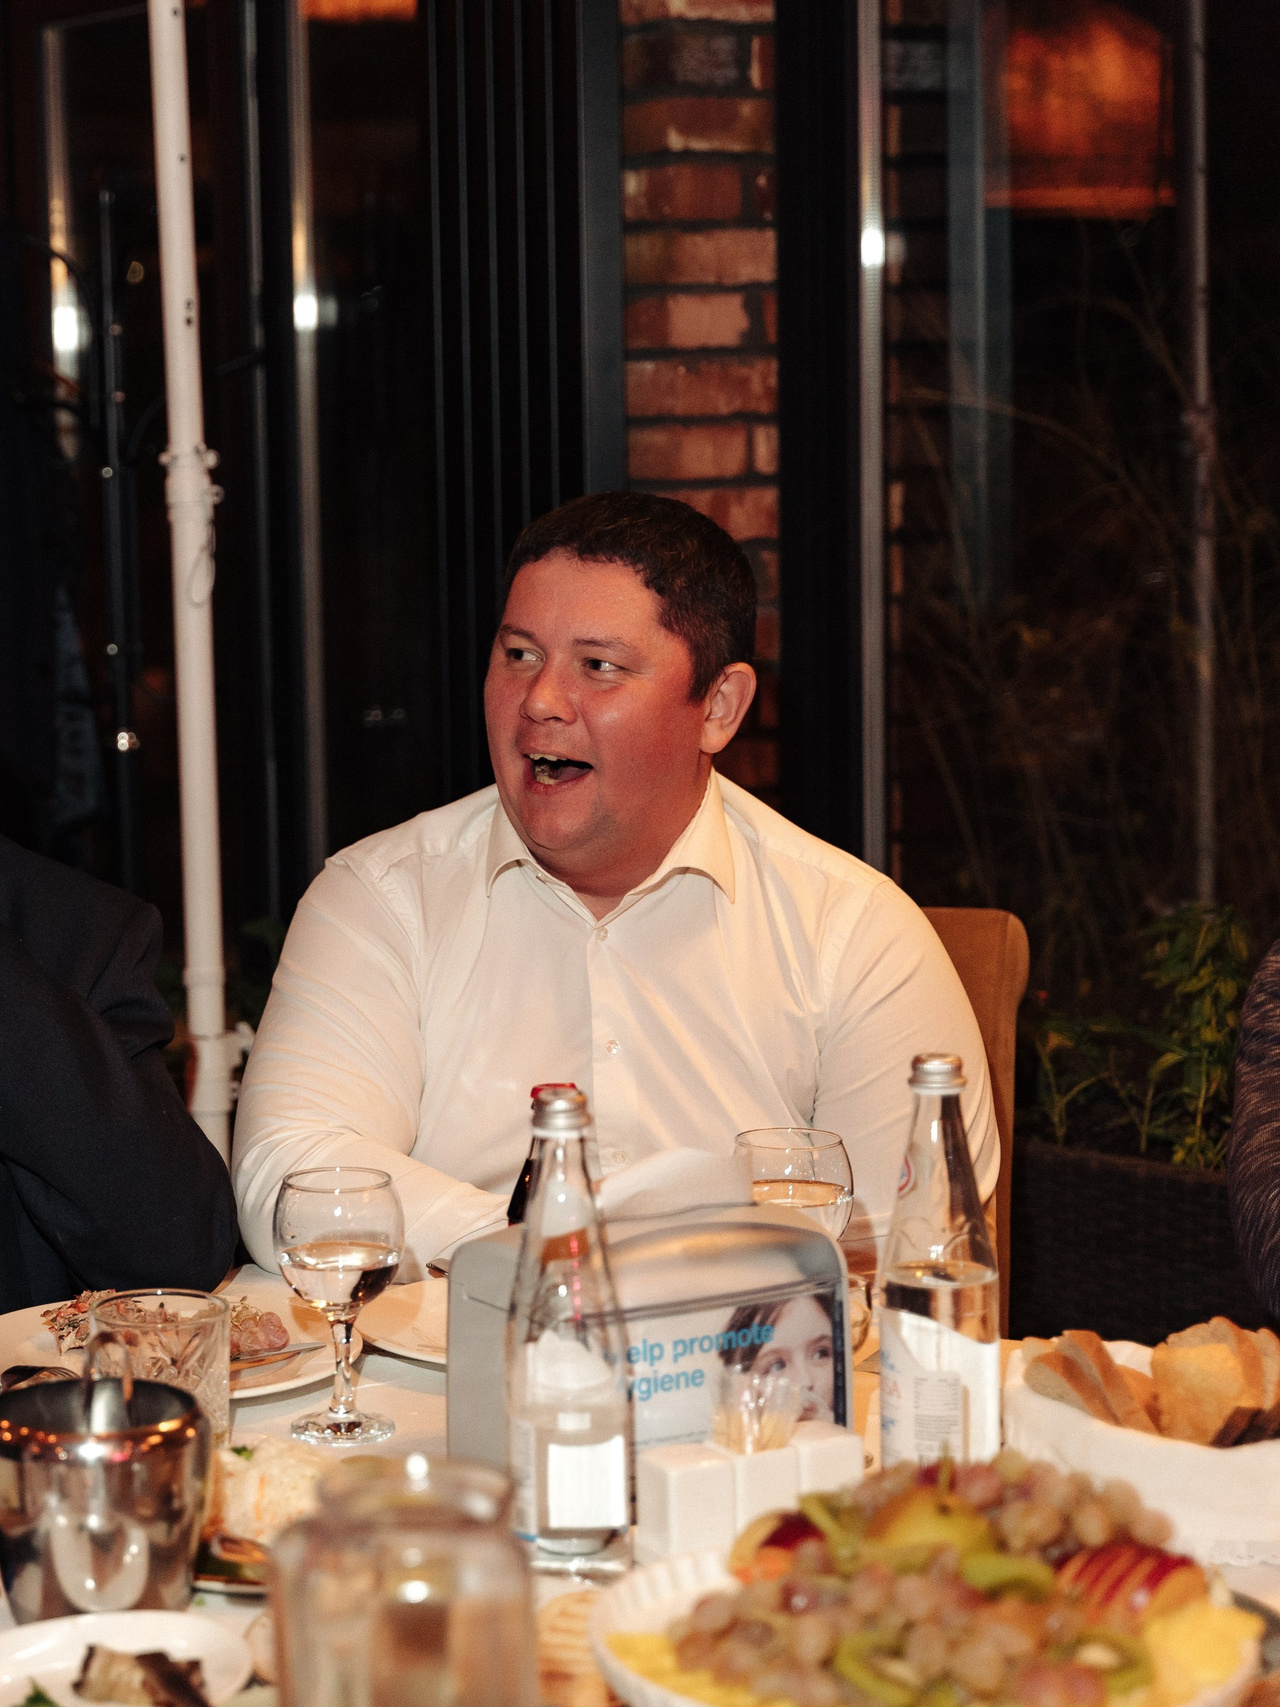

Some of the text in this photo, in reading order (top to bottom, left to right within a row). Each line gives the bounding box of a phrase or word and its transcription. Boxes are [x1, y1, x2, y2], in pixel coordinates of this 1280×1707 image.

[619, 1322, 774, 1367] elp promote
[626, 1368, 705, 1402] giene
